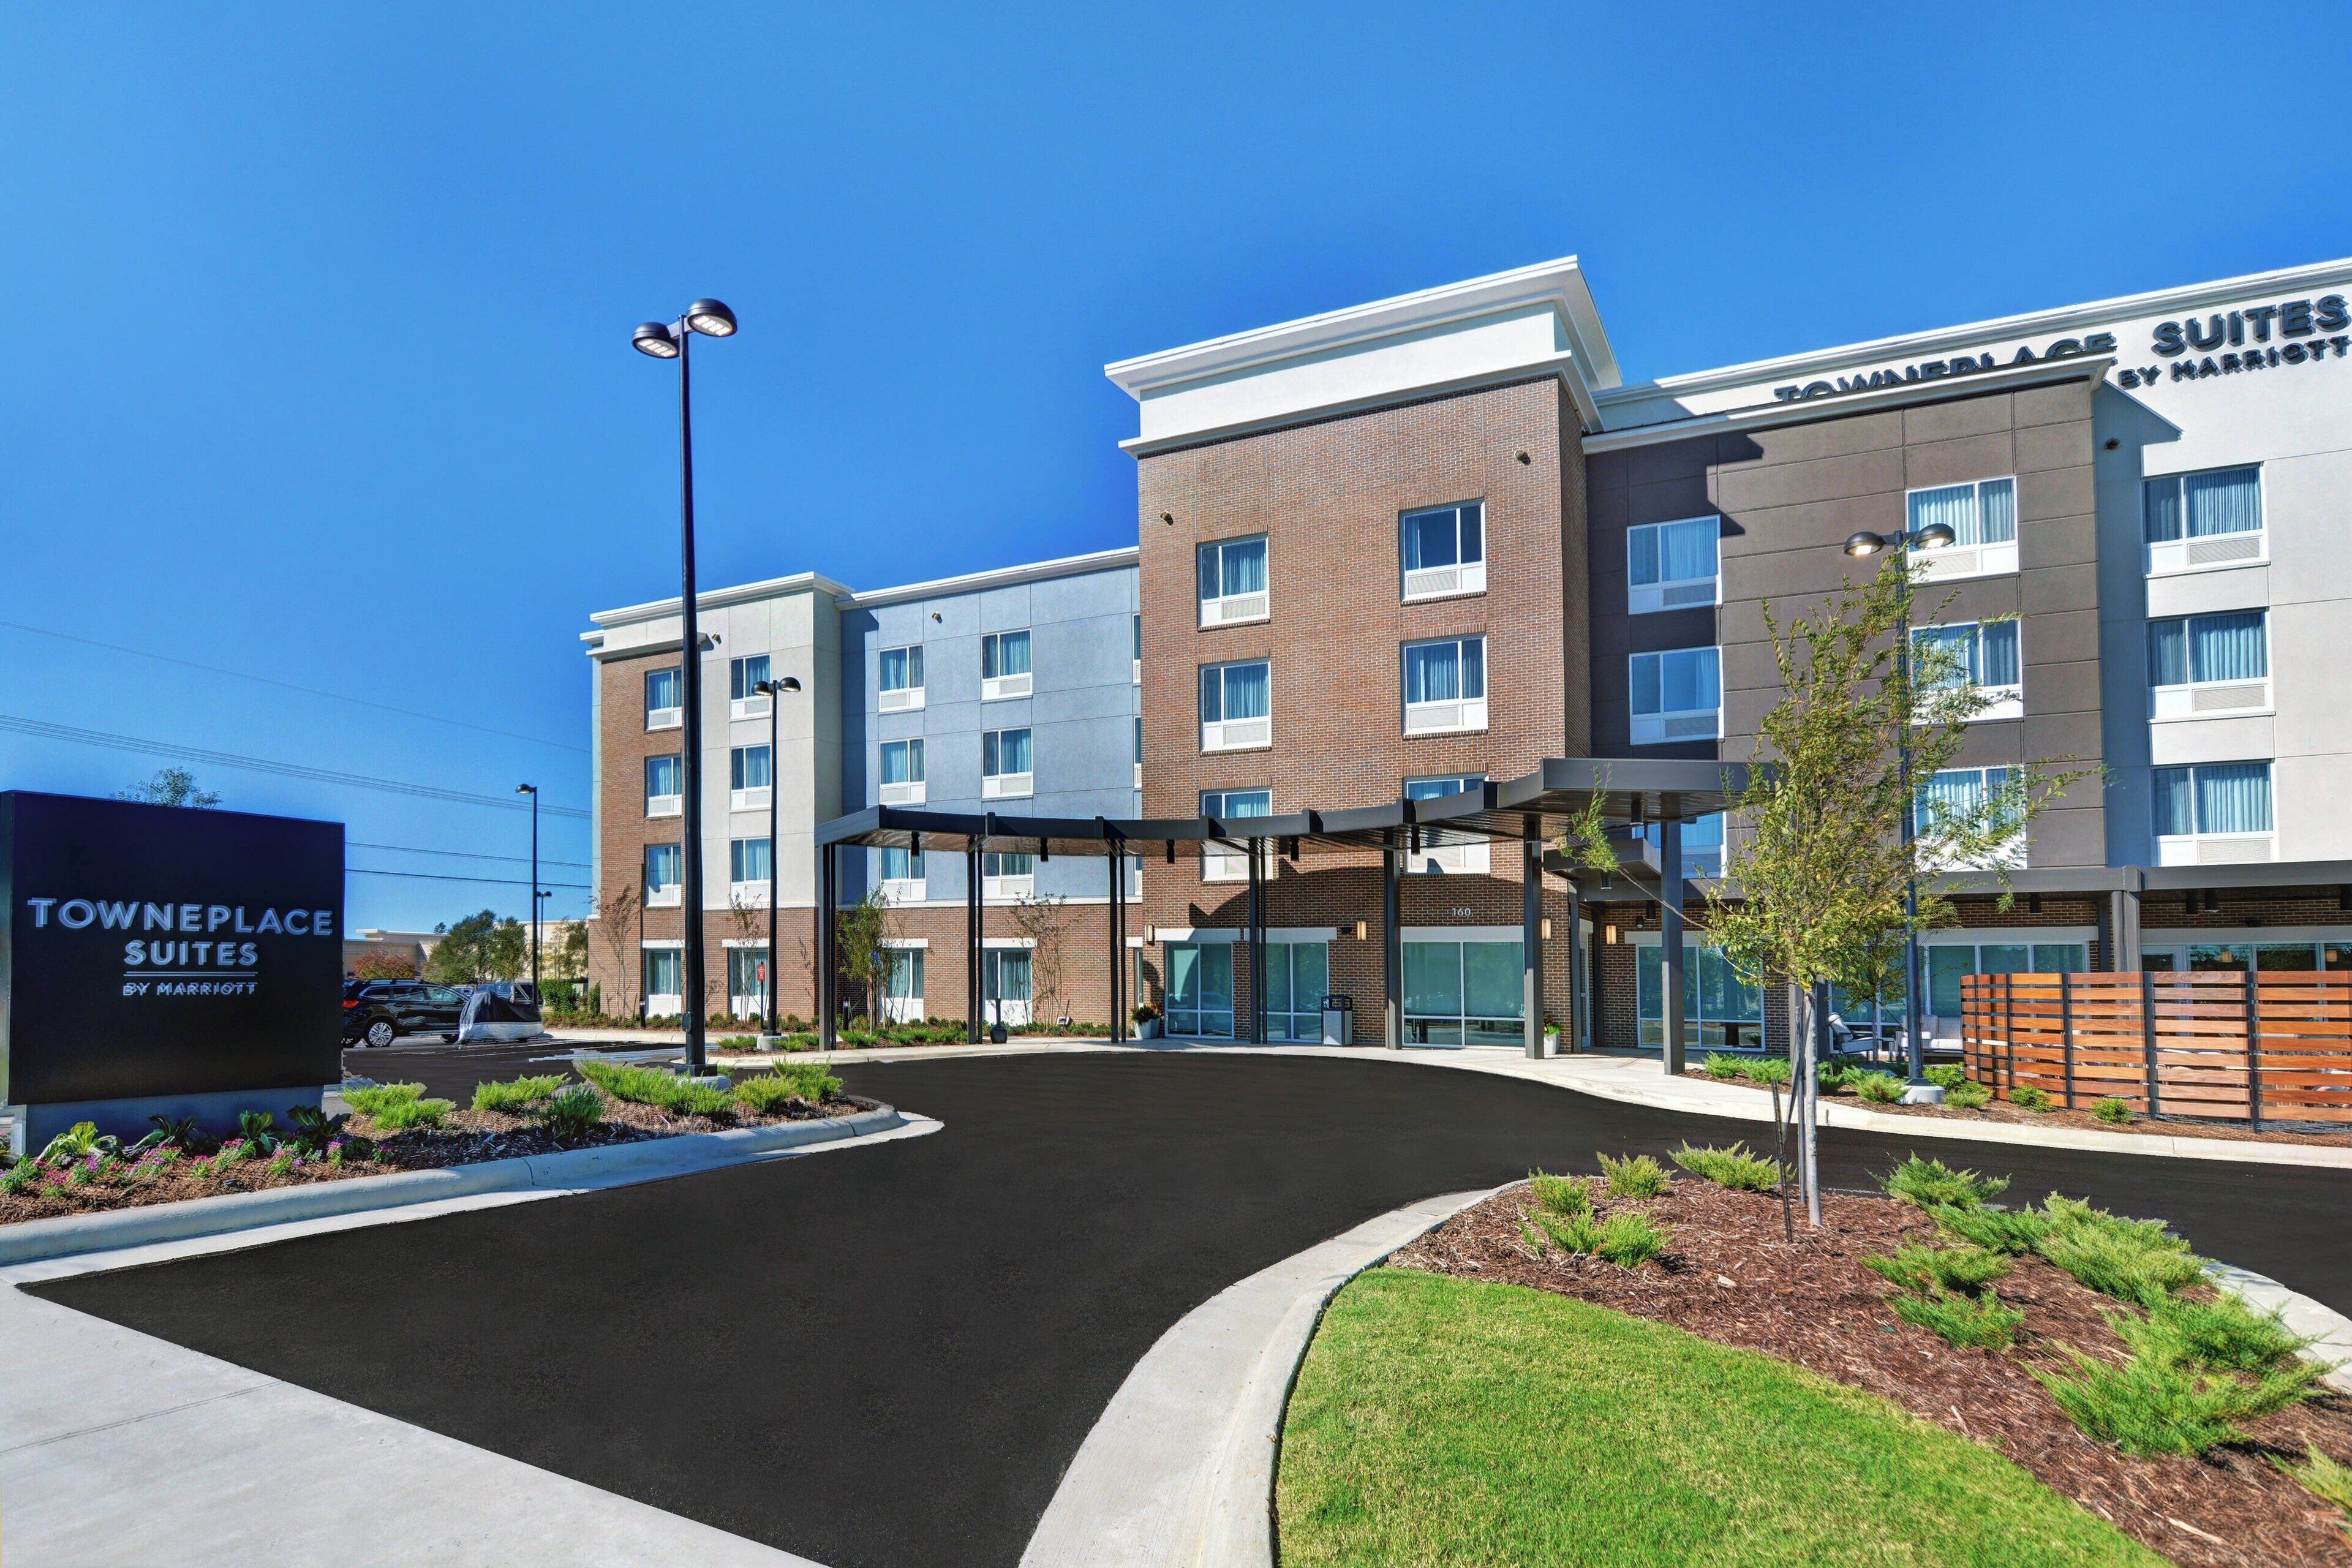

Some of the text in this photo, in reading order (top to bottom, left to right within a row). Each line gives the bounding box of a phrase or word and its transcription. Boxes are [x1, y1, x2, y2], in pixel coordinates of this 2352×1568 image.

[2151, 294, 2351, 358] SUITES
[2118, 335, 2352, 390] BY MARRIOTT
[27, 897, 333, 936] TOWNEPLACE
[1452, 908, 1471, 916] 160
[124, 940, 258, 966] SUITES
[123, 982, 258, 996] BY MARRIOTT
